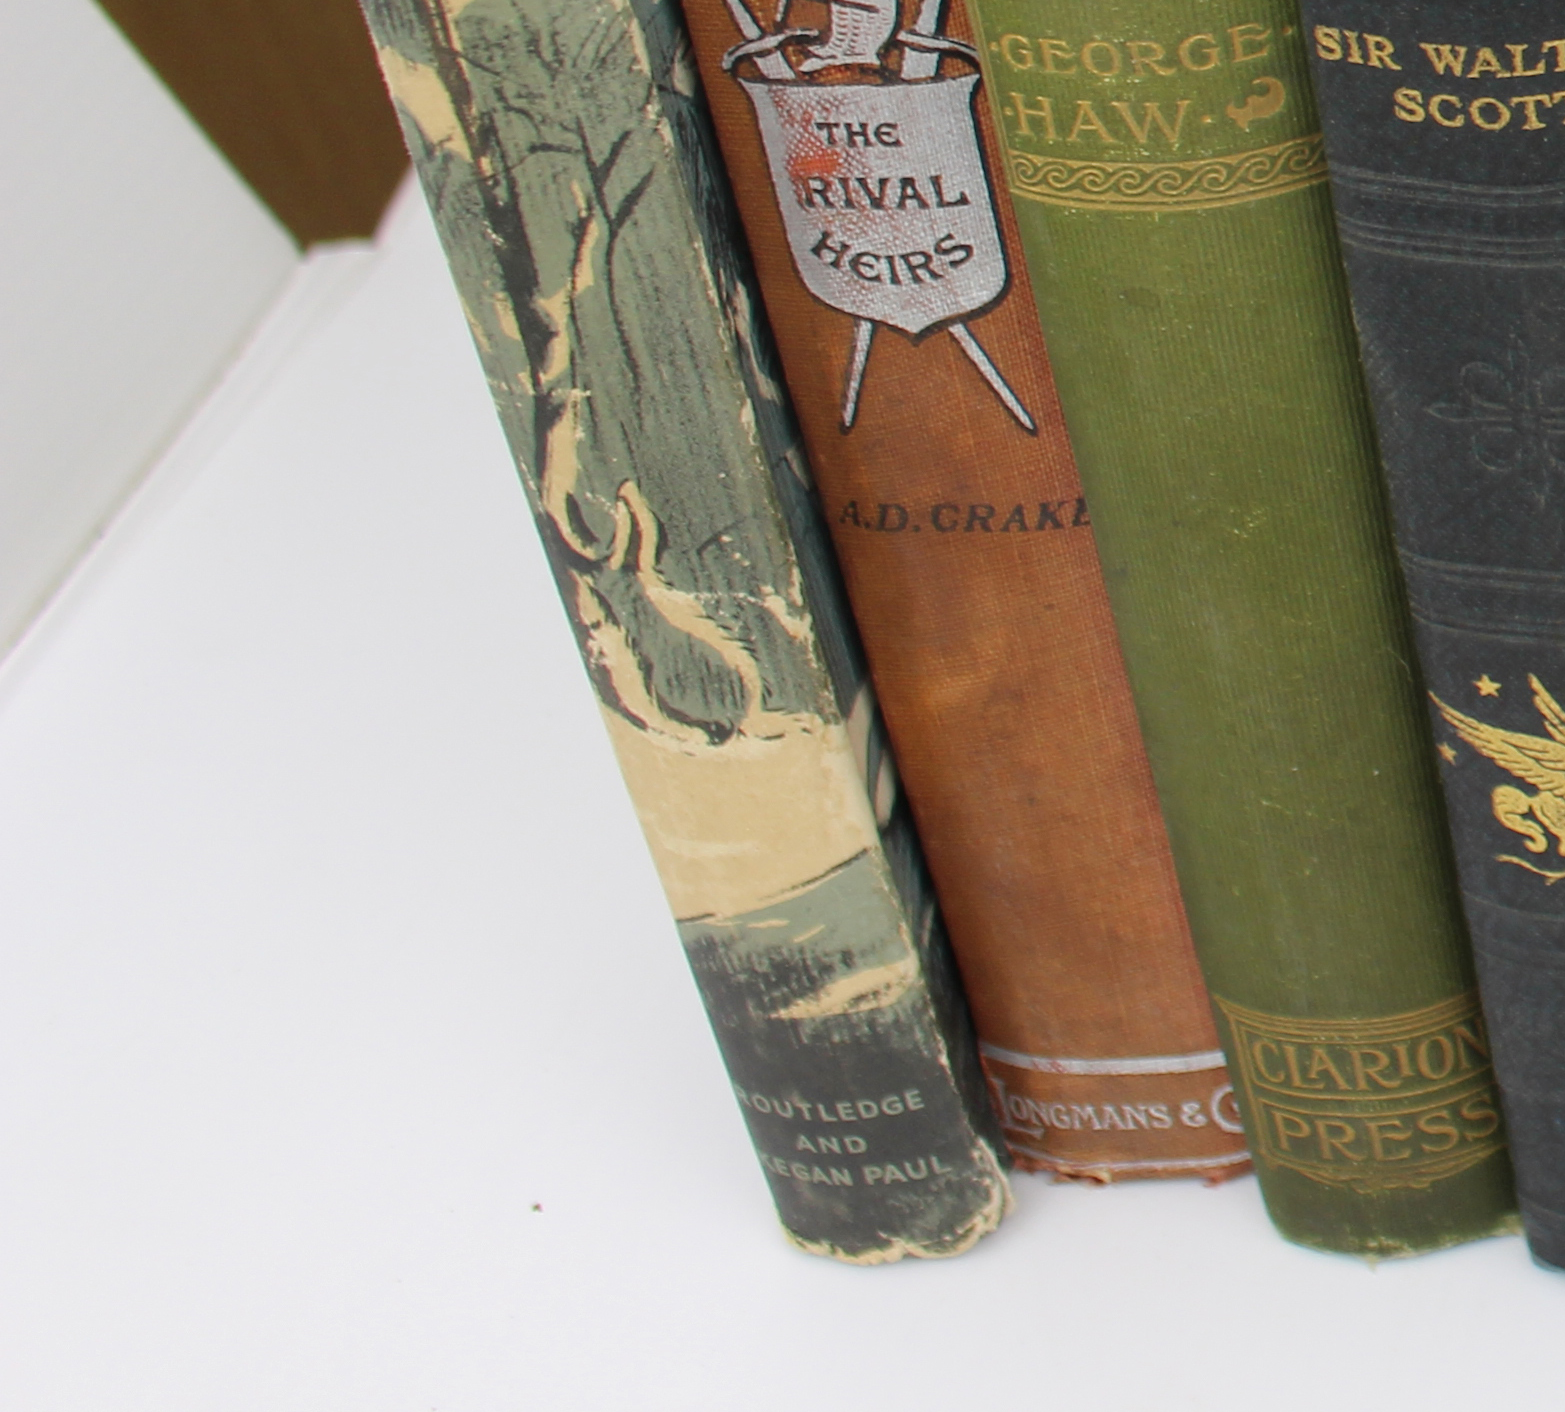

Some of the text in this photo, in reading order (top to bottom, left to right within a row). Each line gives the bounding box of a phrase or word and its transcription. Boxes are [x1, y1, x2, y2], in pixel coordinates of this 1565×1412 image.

[1007, 22, 1274, 78] GEORGE
[1314, 23, 1402, 70] SIR
[815, 122, 905, 147] THE
[1014, 92, 1195, 144] HAW
[804, 174, 972, 209] RIVAL
[810, 230, 975, 285] HEIRS
[1251, 1018, 1488, 1091] CLARION
[734, 1084, 925, 1122] ROUTLEDGE
[991, 1077, 1245, 1139] LONGMANS & C
[795, 1134, 867, 1154] AND
[1271, 1094, 1499, 1162] PRESS
[761, 1153, 952, 1186] KEGAN PAUL
